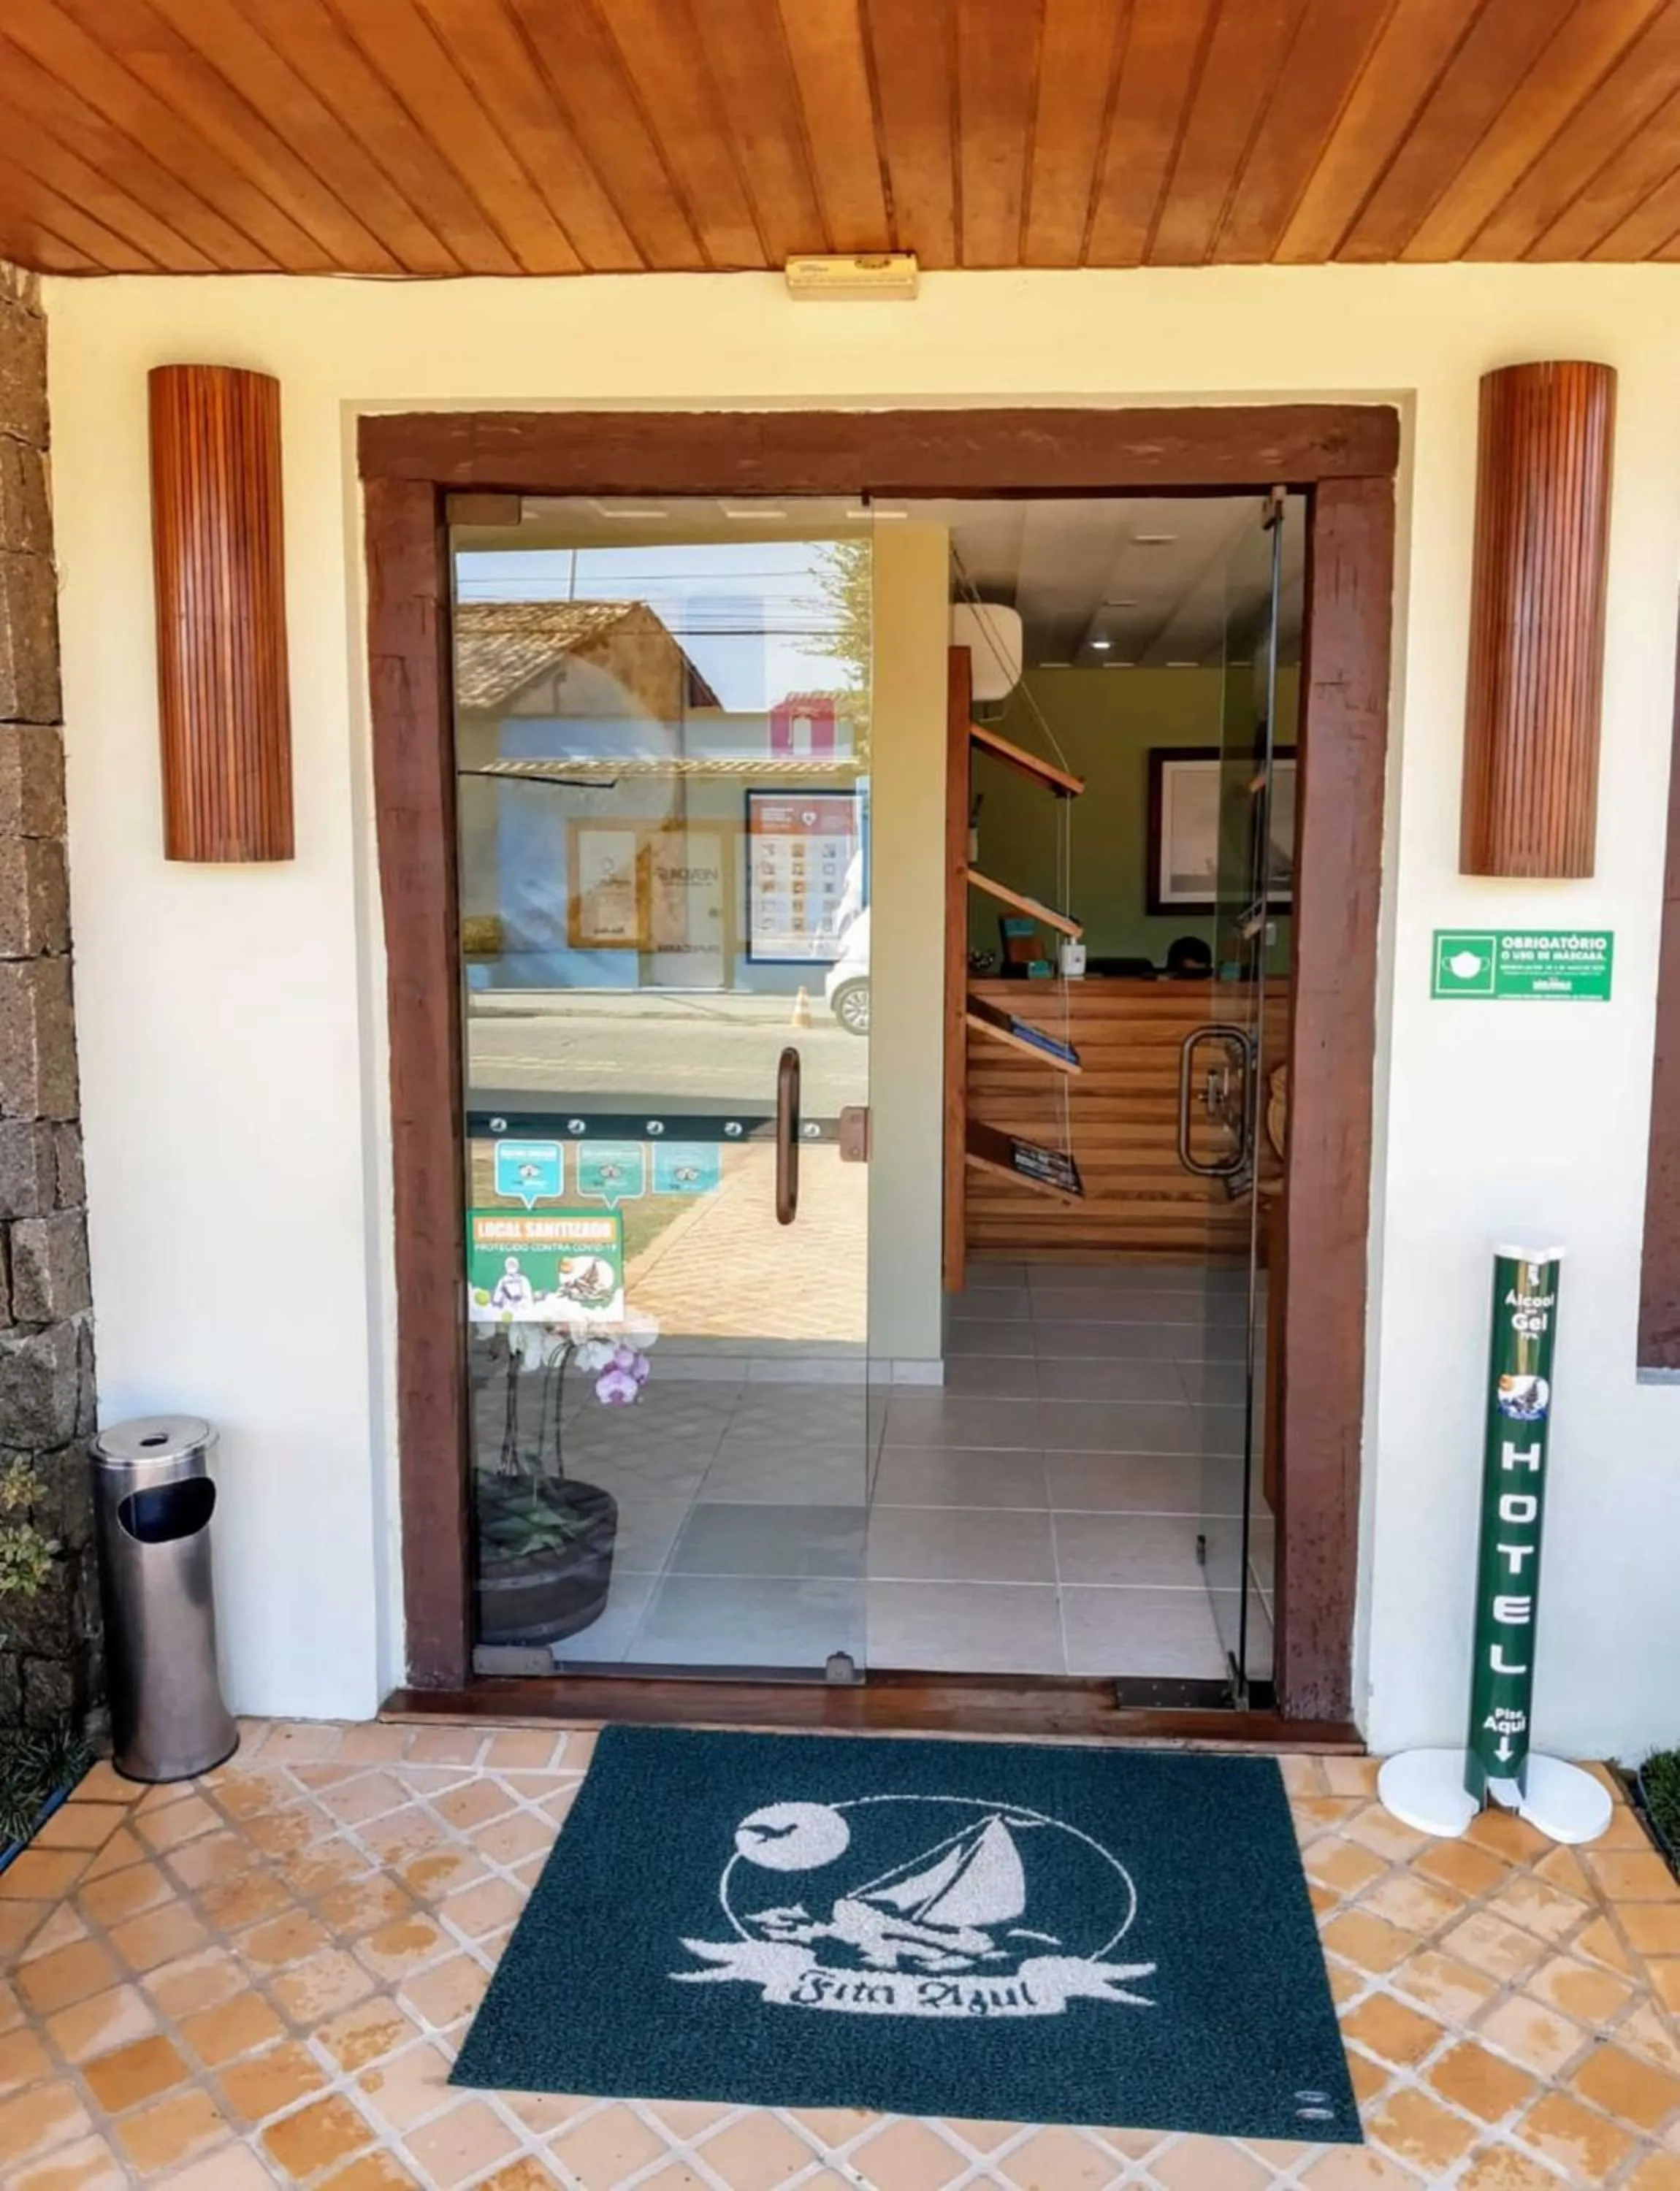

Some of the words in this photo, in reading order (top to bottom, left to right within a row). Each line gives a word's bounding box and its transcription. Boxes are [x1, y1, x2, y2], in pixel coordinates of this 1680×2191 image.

[1502, 935, 1606, 949] OBRIGATÓRIO
[1501, 951, 1510, 960] O
[1512, 951, 1535, 960] USO
[1511, 1312, 1549, 1331] Gel
[1489, 1441, 1541, 1674] HOTEL
[1482, 1715, 1527, 1736] Aqui
[790, 1970, 896, 2005] Fita
[917, 1981, 1038, 2016] Azul
